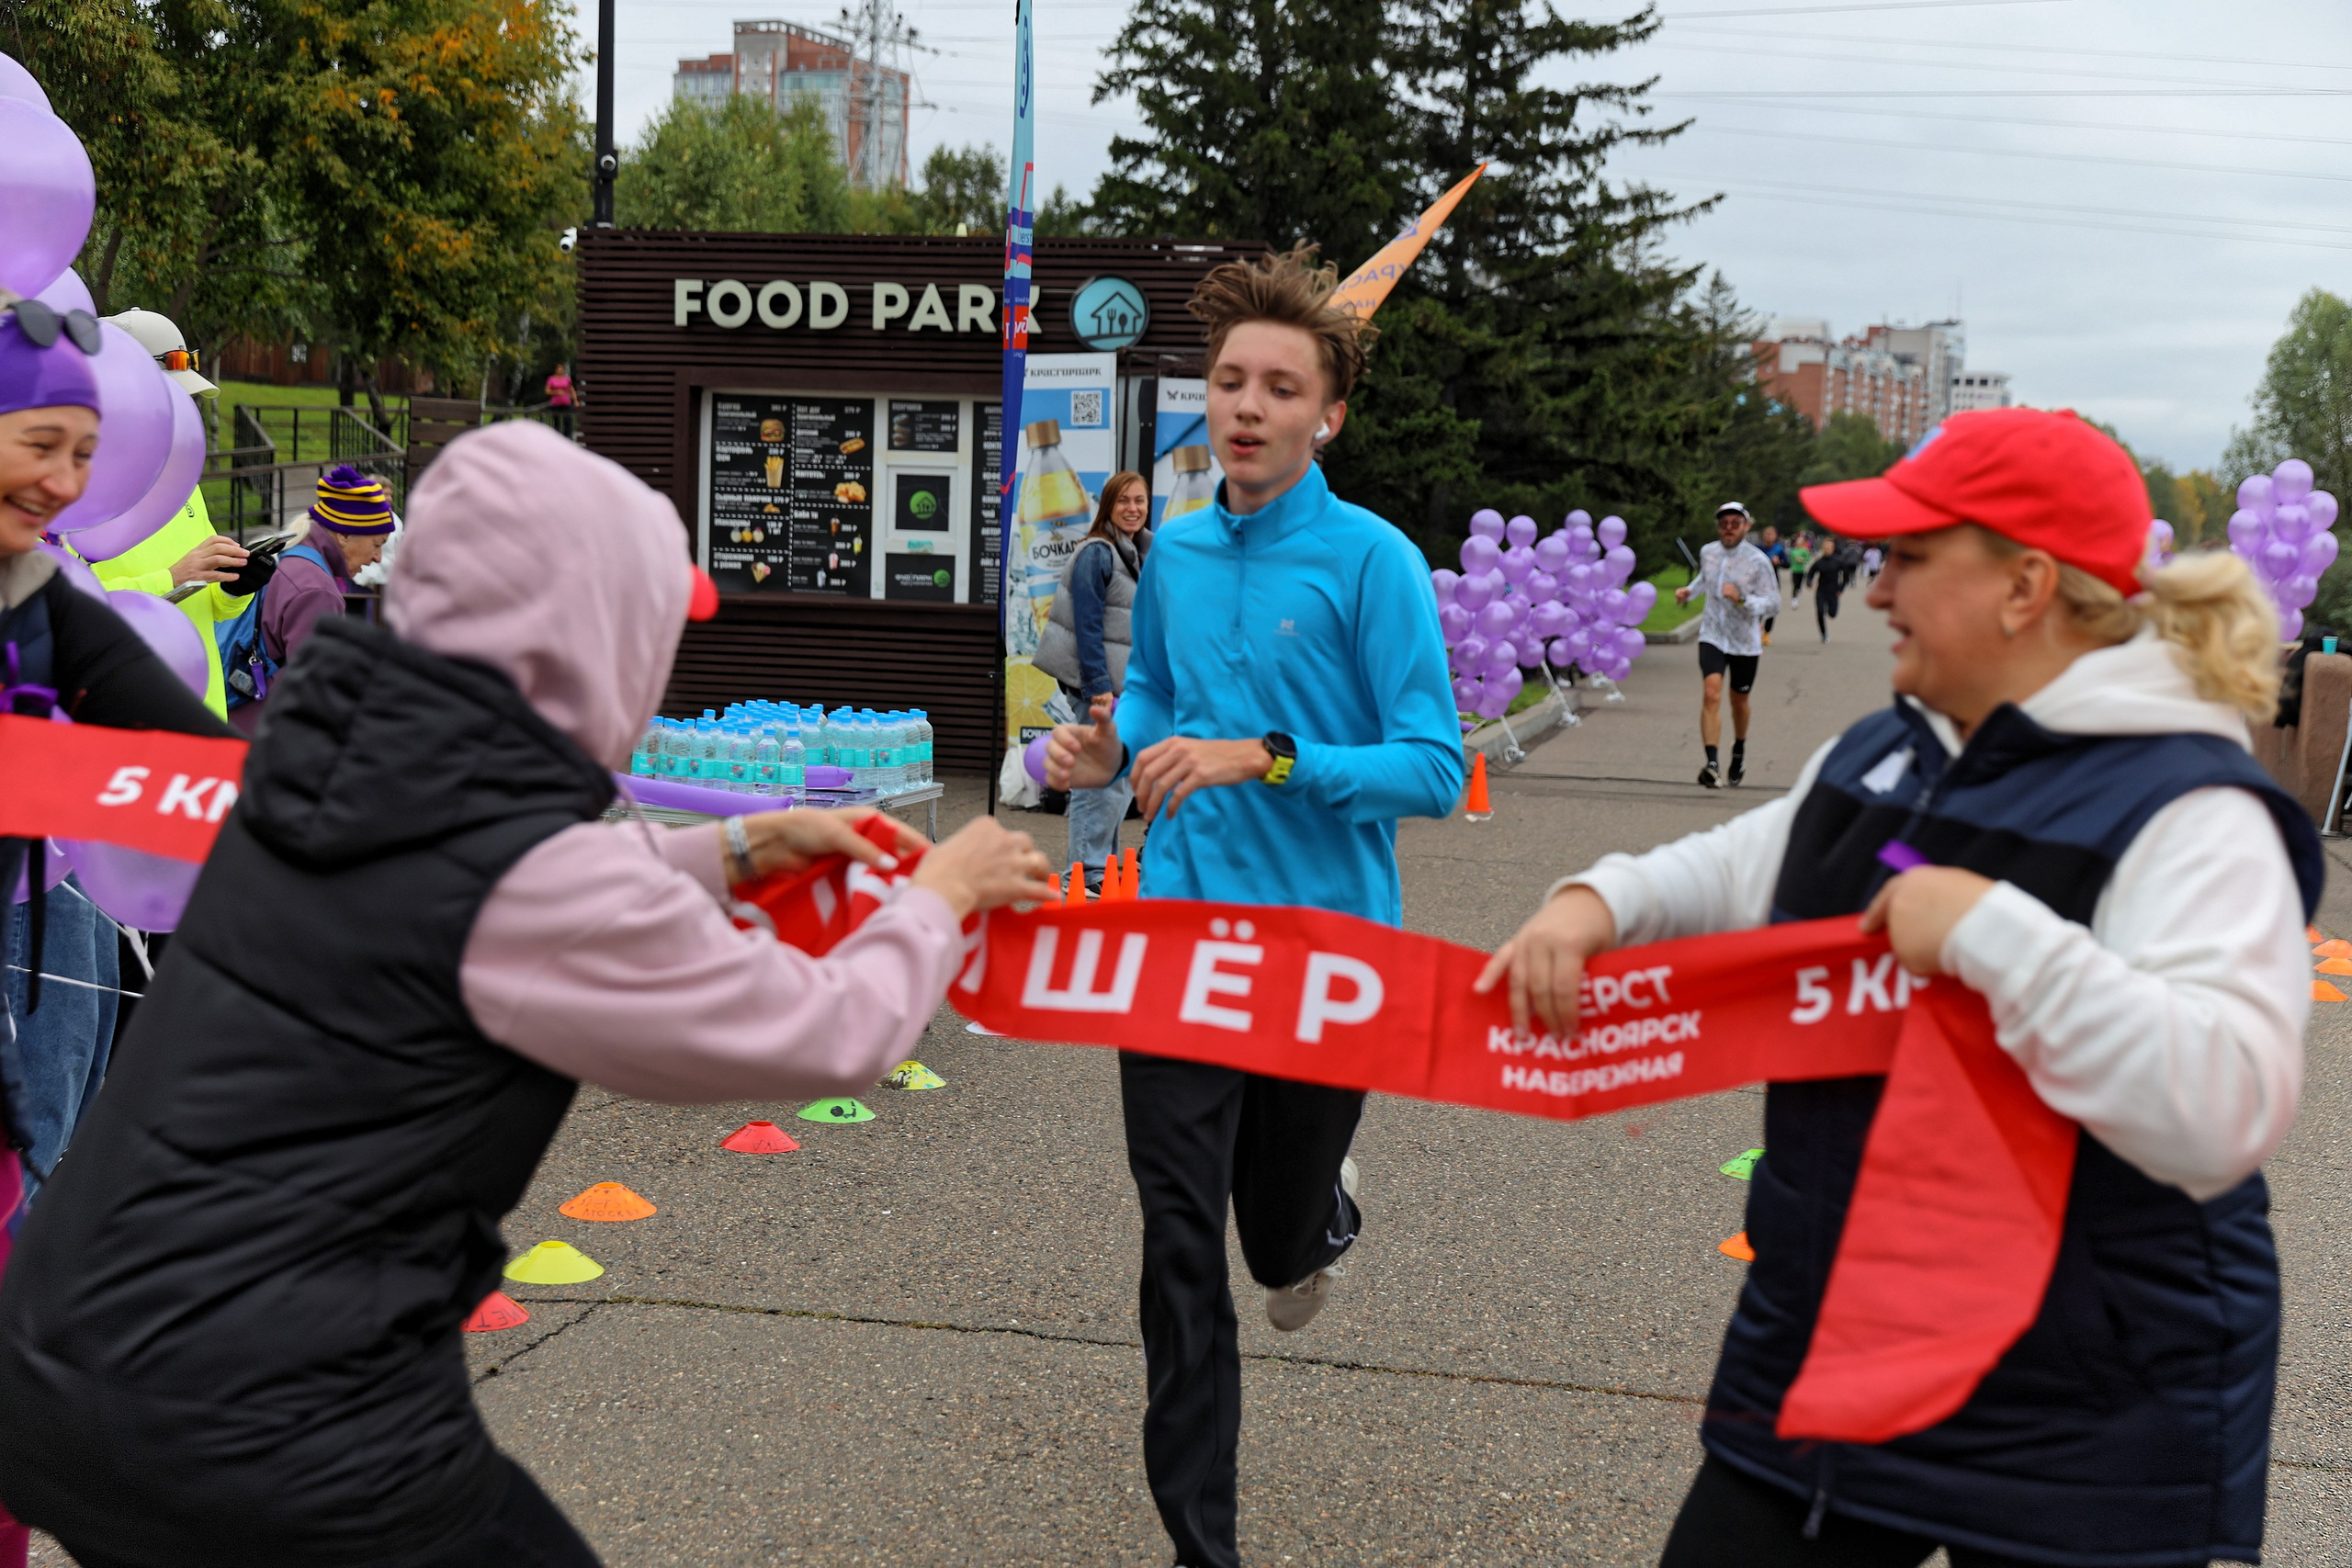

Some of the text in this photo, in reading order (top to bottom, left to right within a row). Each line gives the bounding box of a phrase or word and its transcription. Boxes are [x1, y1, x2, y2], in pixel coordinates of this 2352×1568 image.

[674, 278, 850, 329] FOOD
[96, 765, 151, 806] 5
[1790, 965, 1834, 1025] 5
[1487, 1010, 1702, 1060] КРАСНОЯРСК
[1502, 1051, 1685, 1097] НАБЕРЕЖНАЯ
